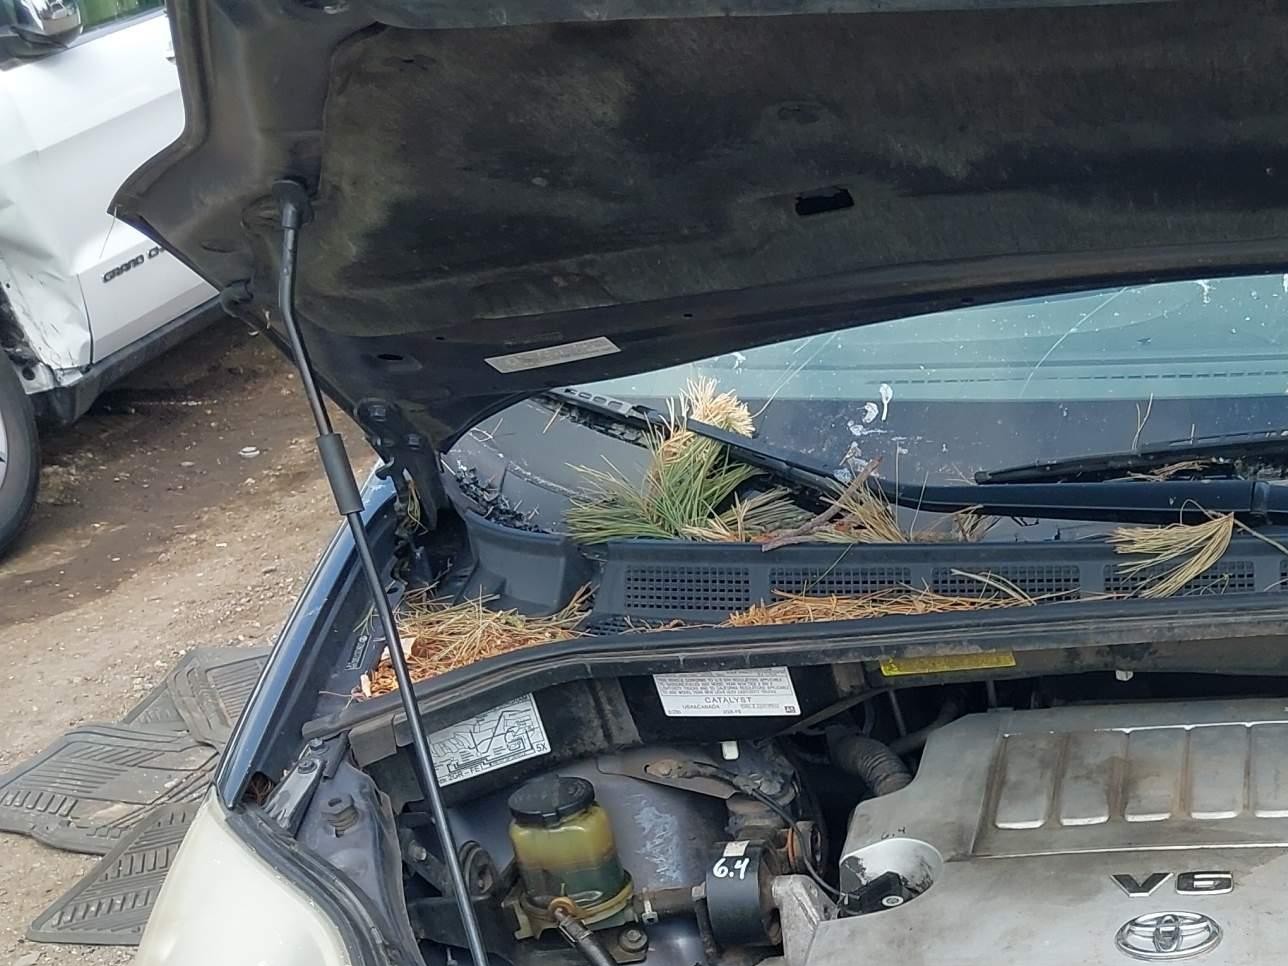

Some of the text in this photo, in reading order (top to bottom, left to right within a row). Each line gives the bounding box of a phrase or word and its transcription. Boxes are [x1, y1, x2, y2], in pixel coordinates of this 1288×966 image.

[103, 254, 145, 283] GRAND
[704, 696, 752, 704] CATALYST
[535, 743, 548, 752] 5X
[712, 857, 751, 880] 6.4
[1110, 870, 1235, 897] V6
